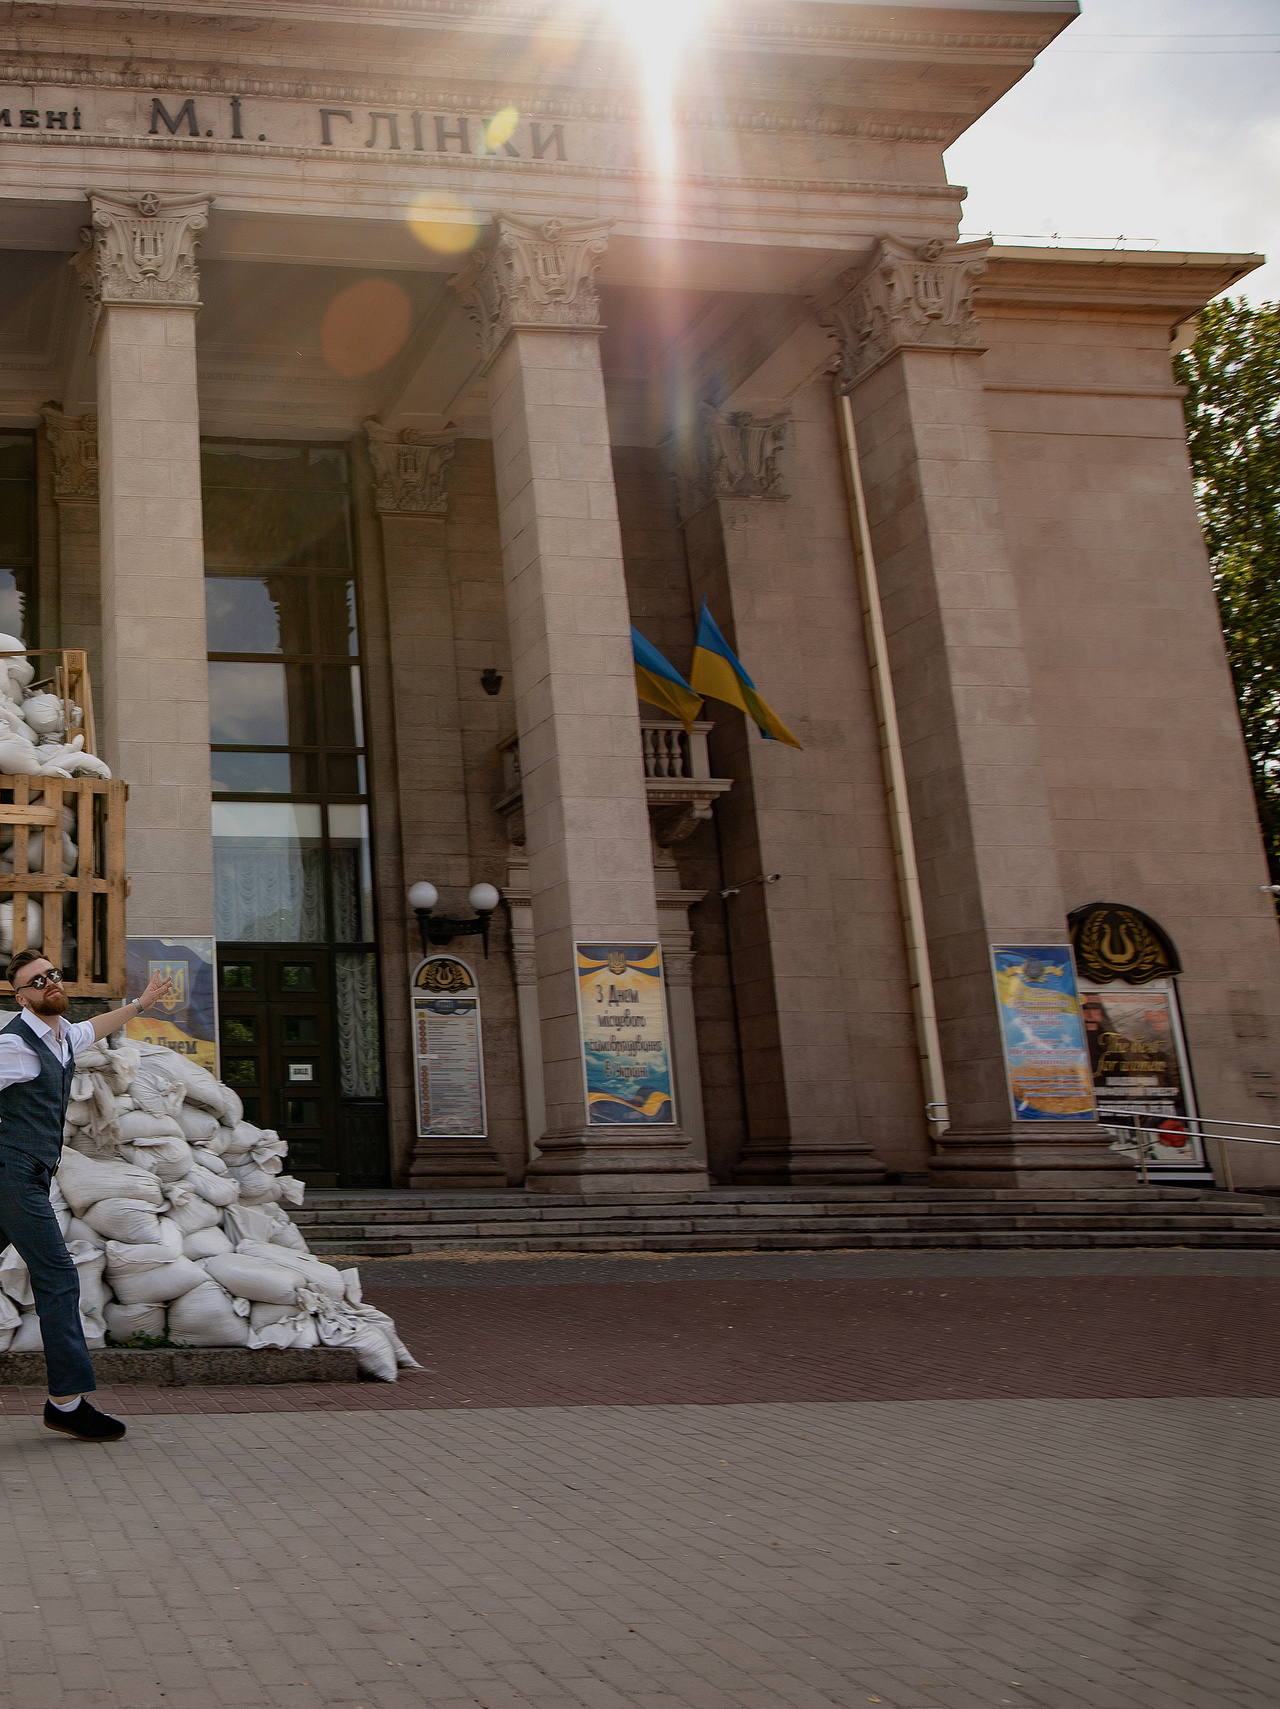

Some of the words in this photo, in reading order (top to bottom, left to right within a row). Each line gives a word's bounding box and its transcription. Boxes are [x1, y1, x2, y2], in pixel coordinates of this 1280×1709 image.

[318, 108, 568, 162] ГЛІНКИ
[608, 984, 640, 1007] Днем
[597, 1008, 646, 1032] місцевого
[1097, 1032, 1130, 1054] The
[1130, 1033, 1166, 1054] best
[1093, 1052, 1119, 1078] for
[1119, 1060, 1167, 1072] women
